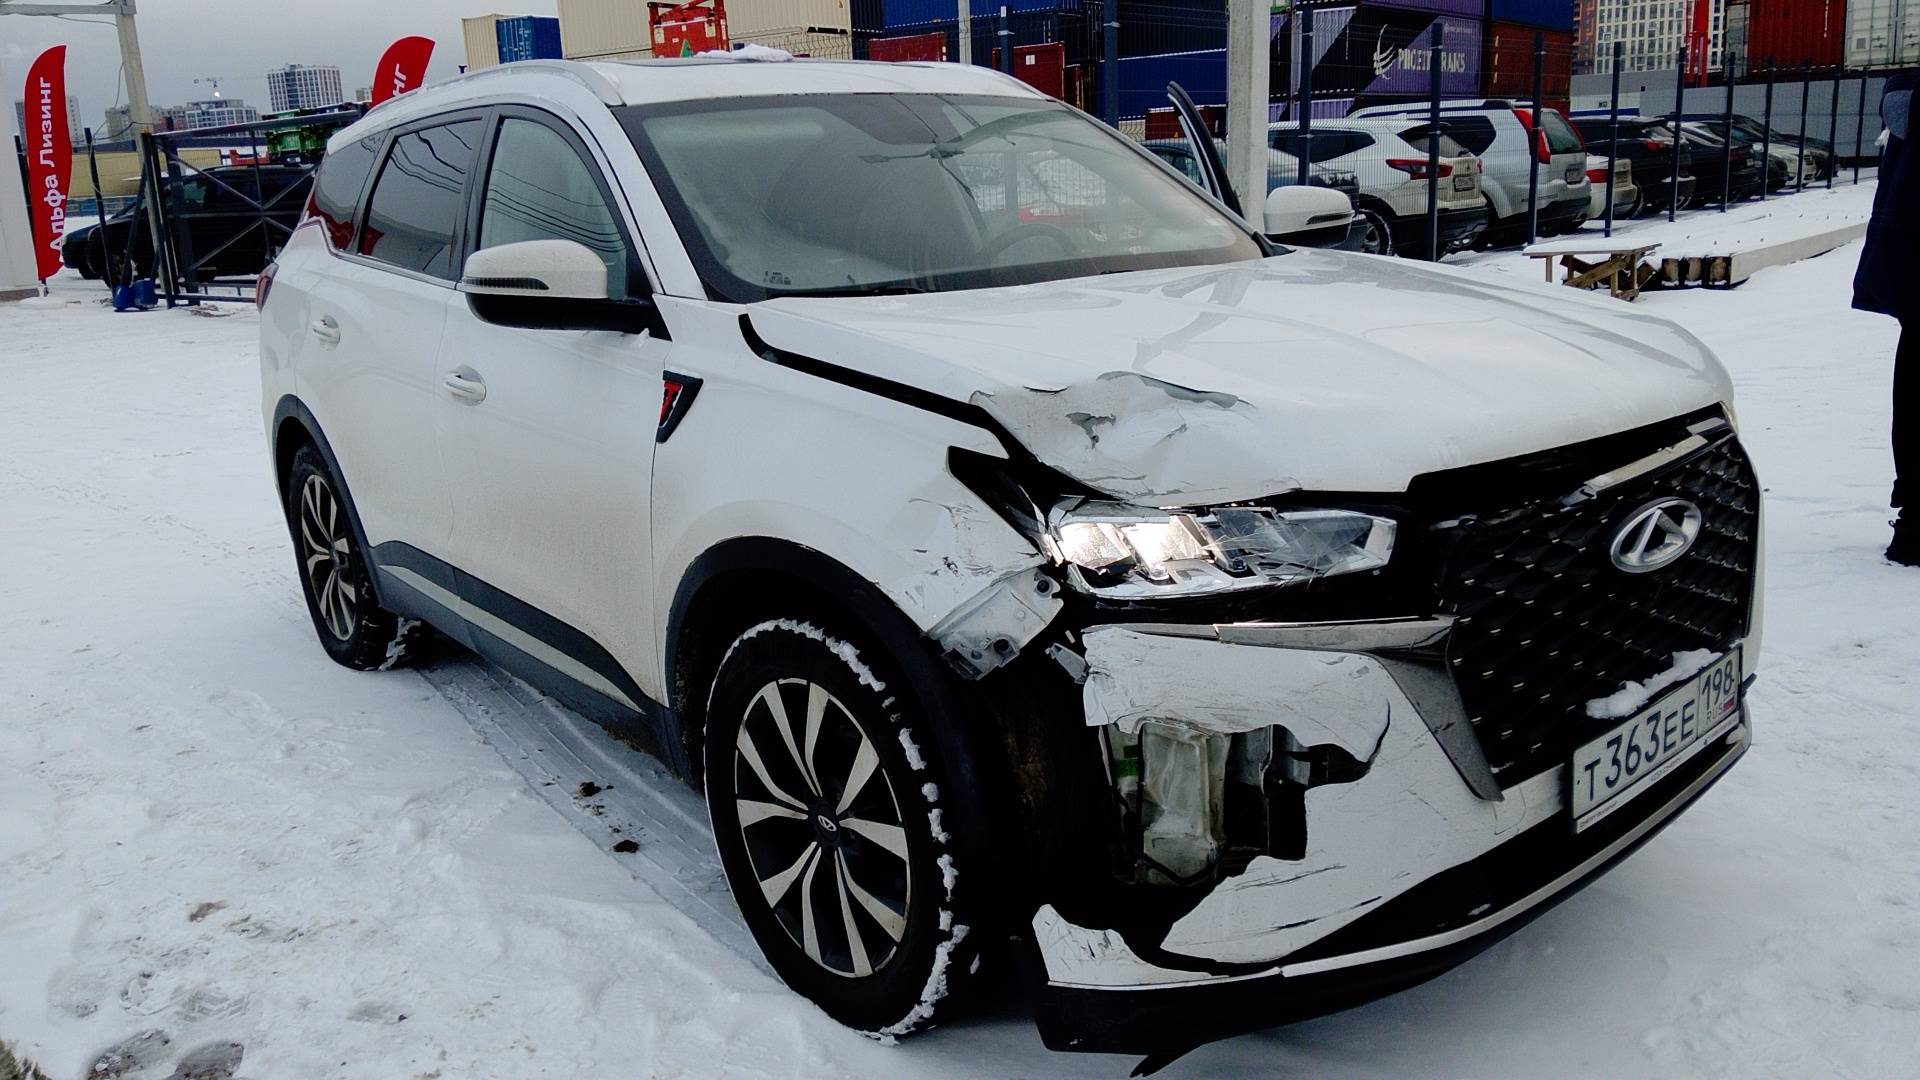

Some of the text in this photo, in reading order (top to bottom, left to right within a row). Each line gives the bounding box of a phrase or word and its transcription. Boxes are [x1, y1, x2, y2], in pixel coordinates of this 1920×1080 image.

[39, 76, 67, 263] Альфа Лизинг
[1702, 659, 1733, 711] 198
[1706, 702, 1723, 725] RUS
